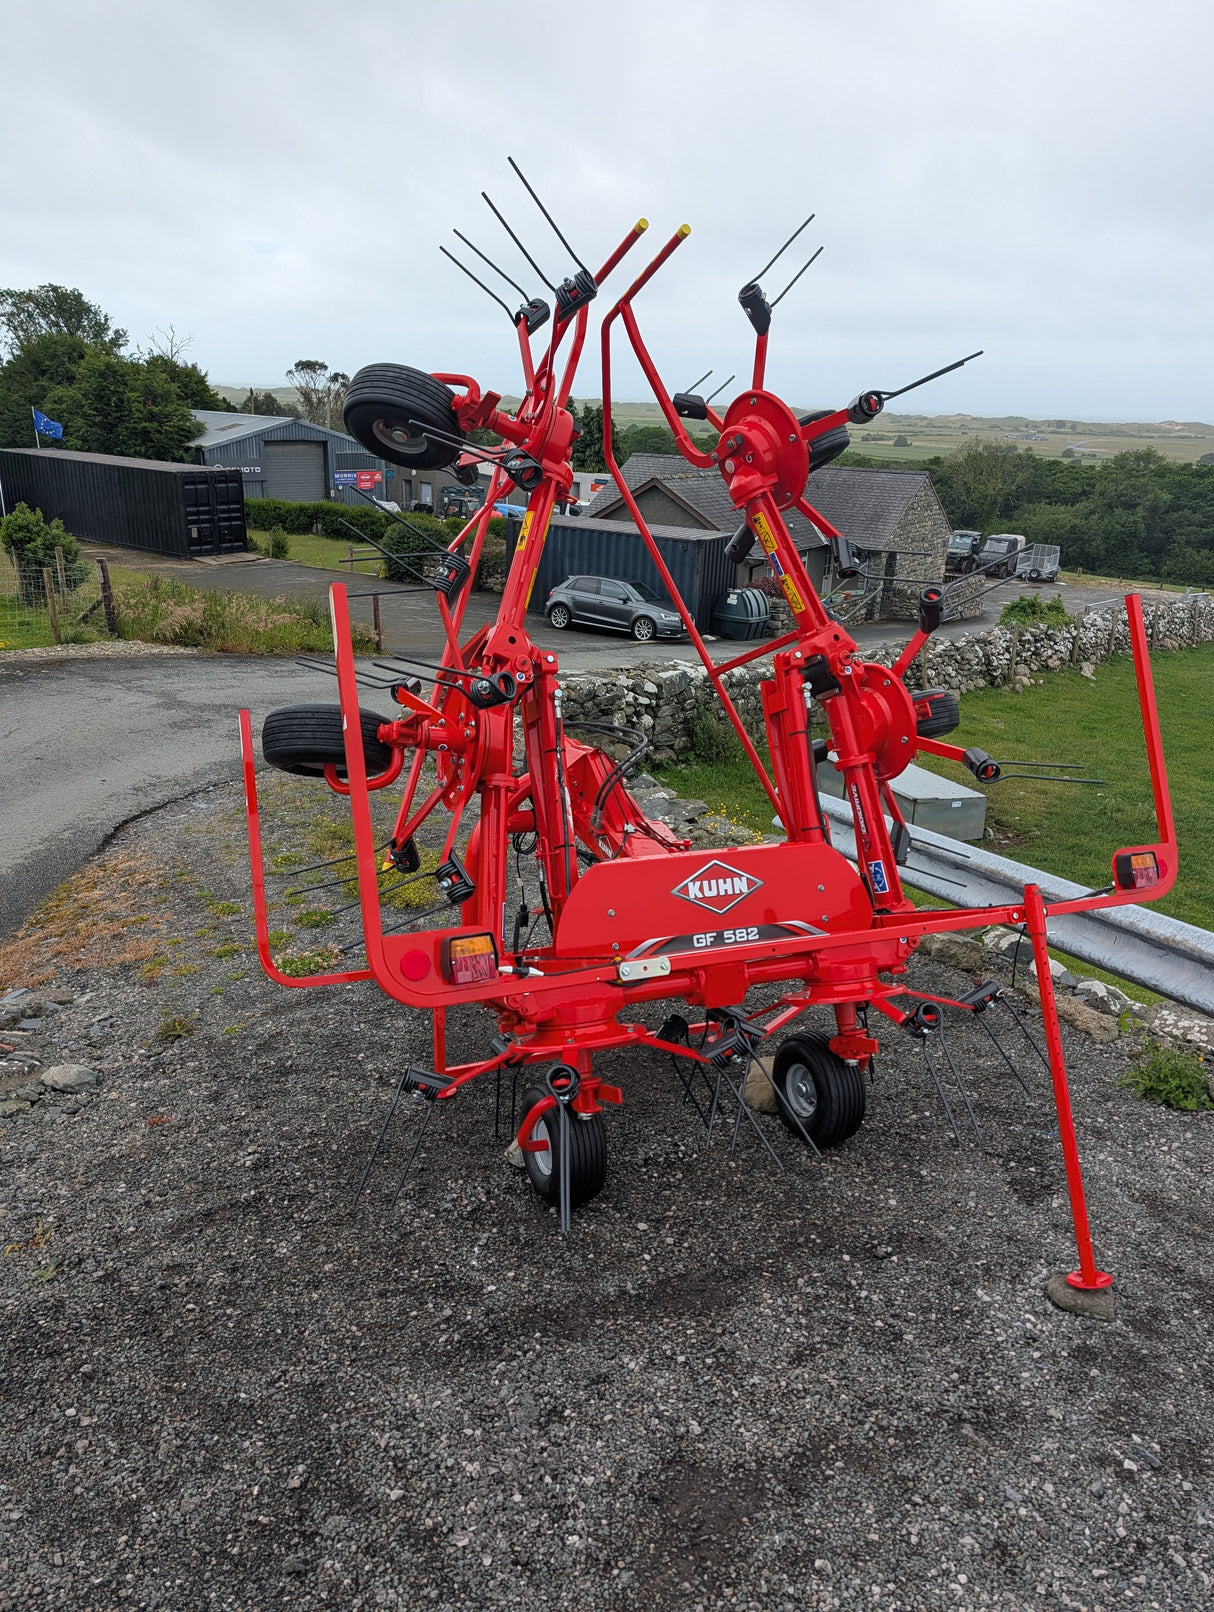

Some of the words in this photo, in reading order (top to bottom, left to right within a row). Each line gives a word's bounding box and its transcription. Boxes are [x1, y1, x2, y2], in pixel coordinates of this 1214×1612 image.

[687, 876, 749, 899] KUHN
[693, 932, 717, 947] GF
[723, 927, 759, 943] 582
